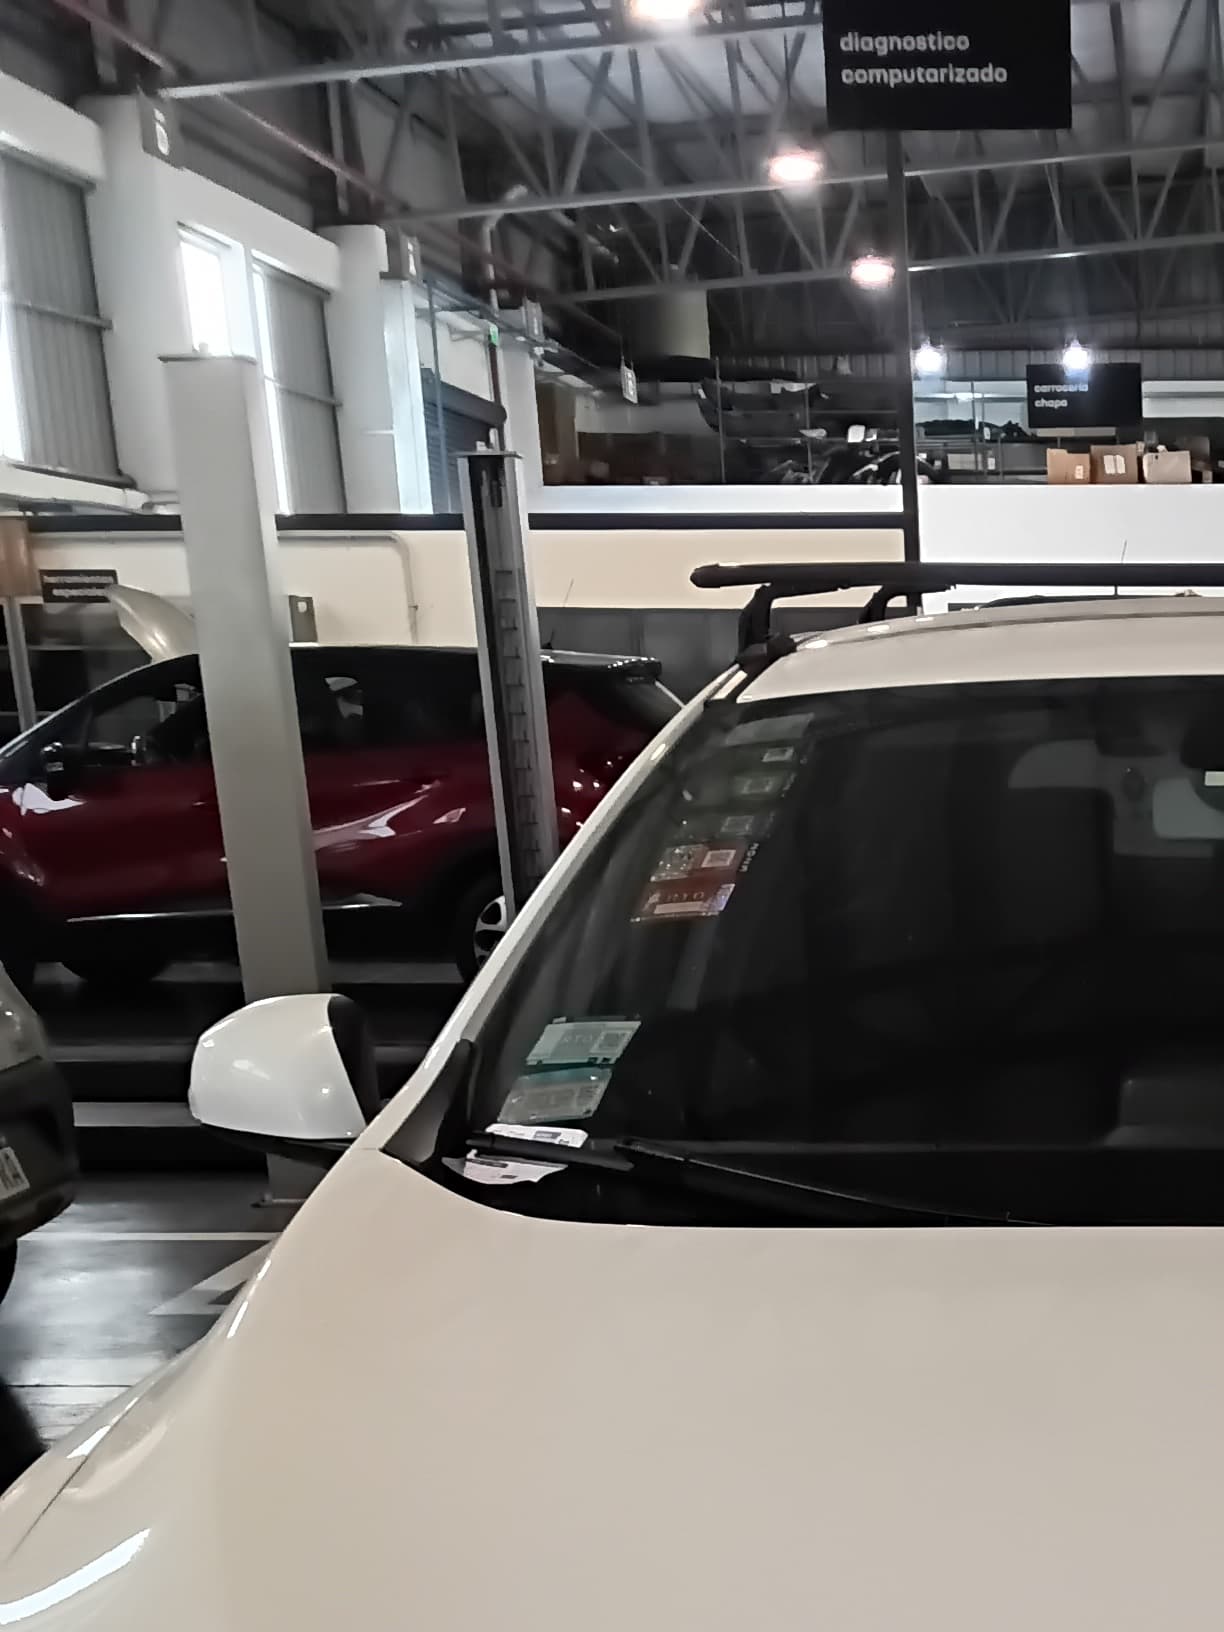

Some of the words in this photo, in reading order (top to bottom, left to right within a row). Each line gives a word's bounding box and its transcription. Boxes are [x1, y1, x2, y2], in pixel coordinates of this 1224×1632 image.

[840, 31, 970, 56] diagnostico
[841, 63, 1008, 88] computarizado
[1034, 398, 1068, 409] chapa
